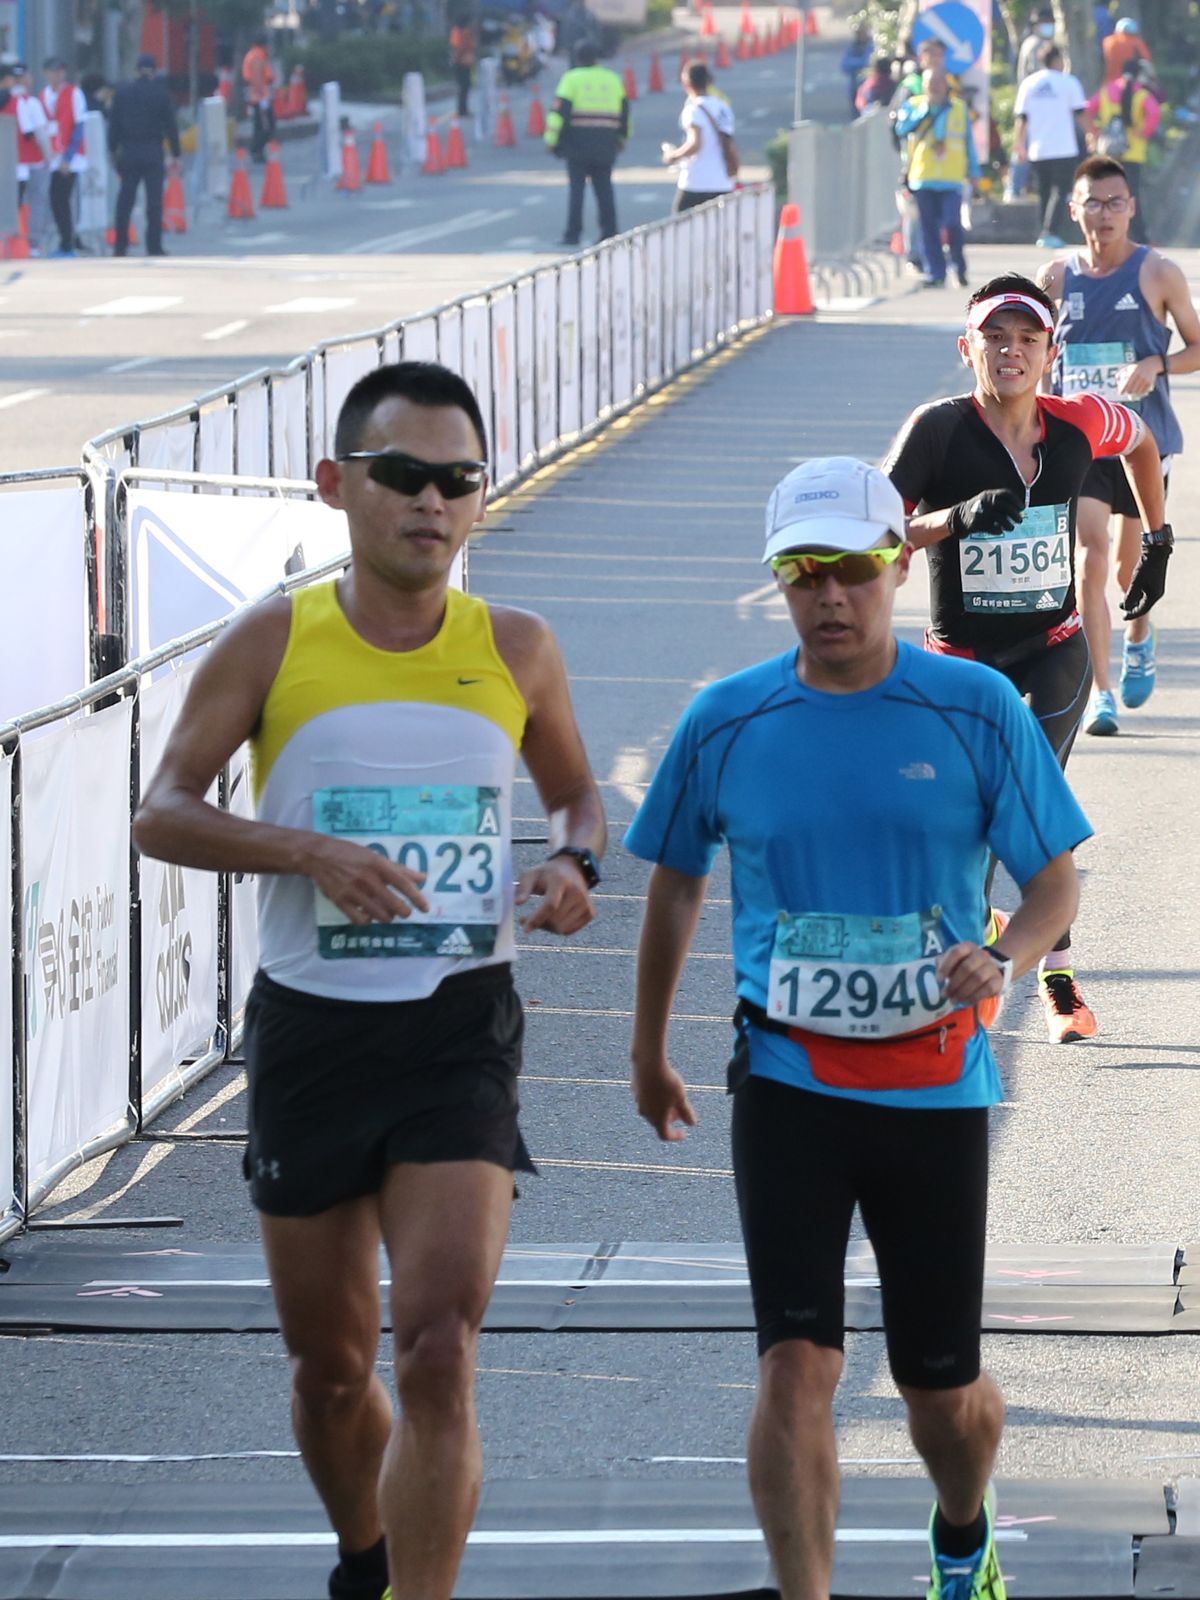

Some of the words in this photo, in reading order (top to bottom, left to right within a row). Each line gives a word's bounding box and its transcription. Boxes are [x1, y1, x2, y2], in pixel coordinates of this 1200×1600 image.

[1066, 367, 1119, 390] 1045
[1057, 516, 1068, 533] B
[964, 537, 1067, 575] 21564
[478, 806, 498, 834] A
[366, 842, 494, 894] 023
[923, 930, 943, 957] A
[779, 964, 949, 1019] 12940
